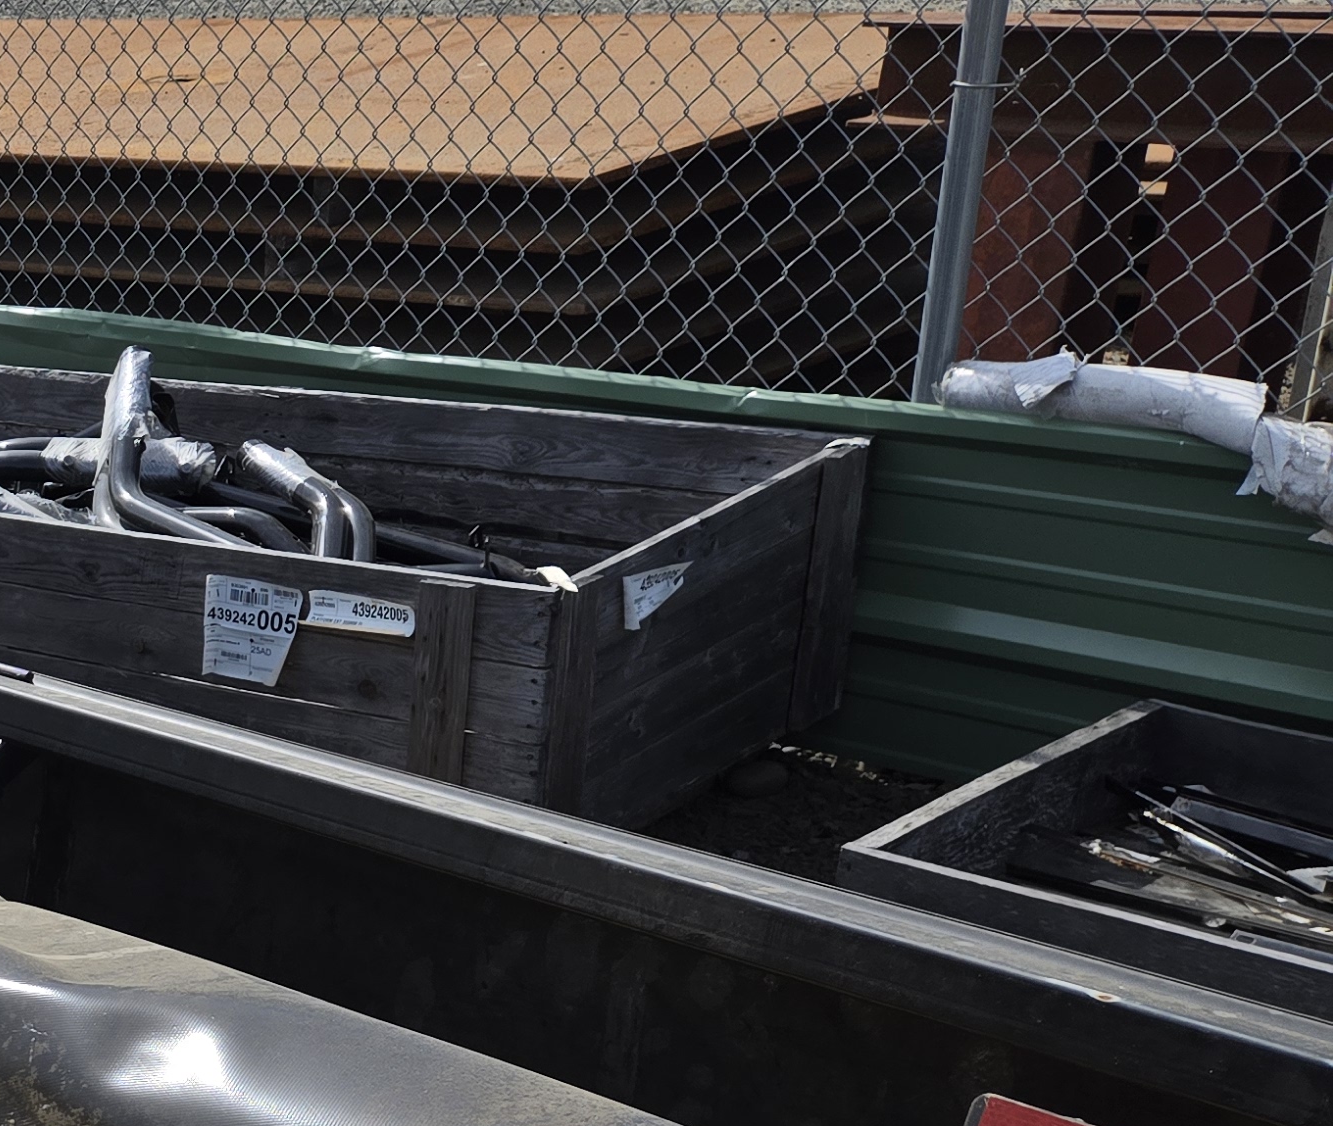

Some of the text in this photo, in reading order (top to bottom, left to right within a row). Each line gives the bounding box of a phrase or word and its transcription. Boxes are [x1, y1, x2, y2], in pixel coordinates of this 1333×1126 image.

[207, 606, 297, 634] 439242005
[352, 602, 409, 622] 439242005
[250, 645, 272, 657] 25AD
